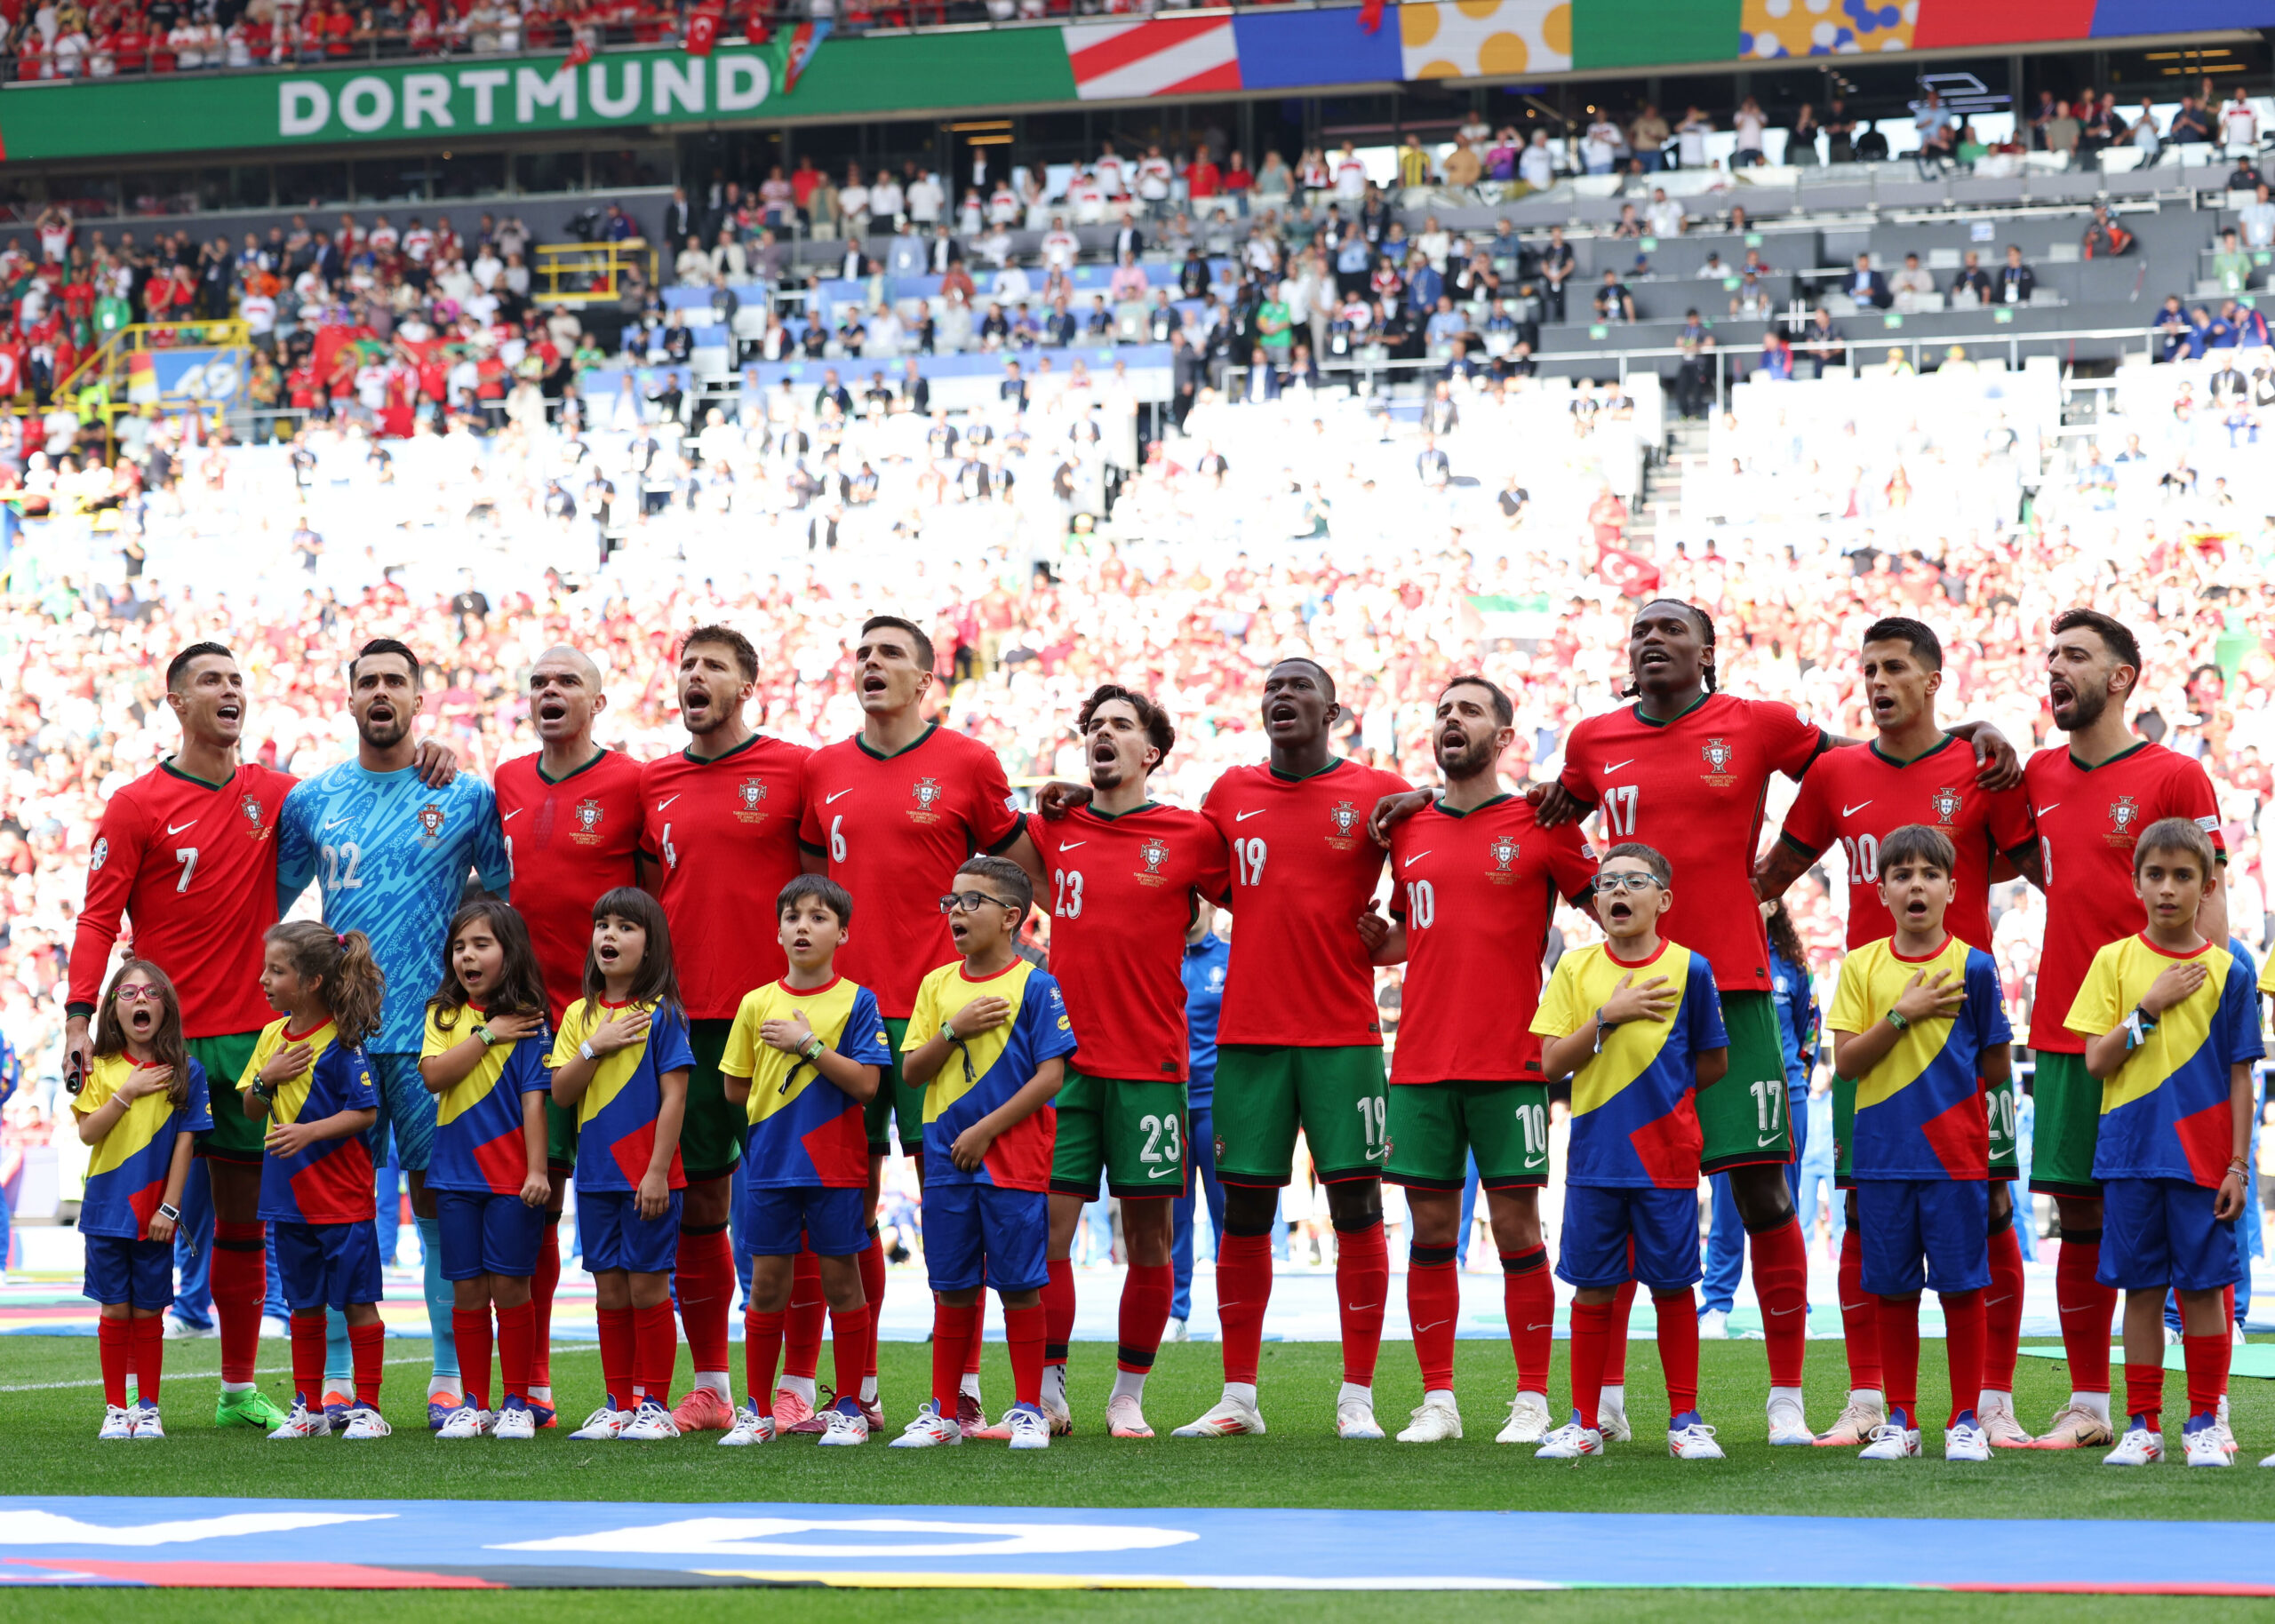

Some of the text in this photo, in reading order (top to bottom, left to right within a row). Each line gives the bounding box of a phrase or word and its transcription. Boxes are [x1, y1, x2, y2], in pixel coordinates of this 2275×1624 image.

[278, 53, 770, 136] DORTMUND
[1604, 784, 1639, 837] 17
[661, 823, 677, 869] 4
[830, 815, 847, 864] 6
[1233, 837, 1267, 887] 19
[1845, 833, 1880, 885] 20
[176, 848, 199, 893] 7
[322, 841, 363, 891] 22
[1054, 868, 1084, 919] 23
[1407, 880, 1434, 930] 10
[1357, 1095, 1386, 1146] 19
[1515, 1103, 1546, 1154] 10
[1750, 1080, 1783, 1131] 17
[1987, 1089, 2016, 1141] 20
[1139, 1114, 1180, 1163] 23
